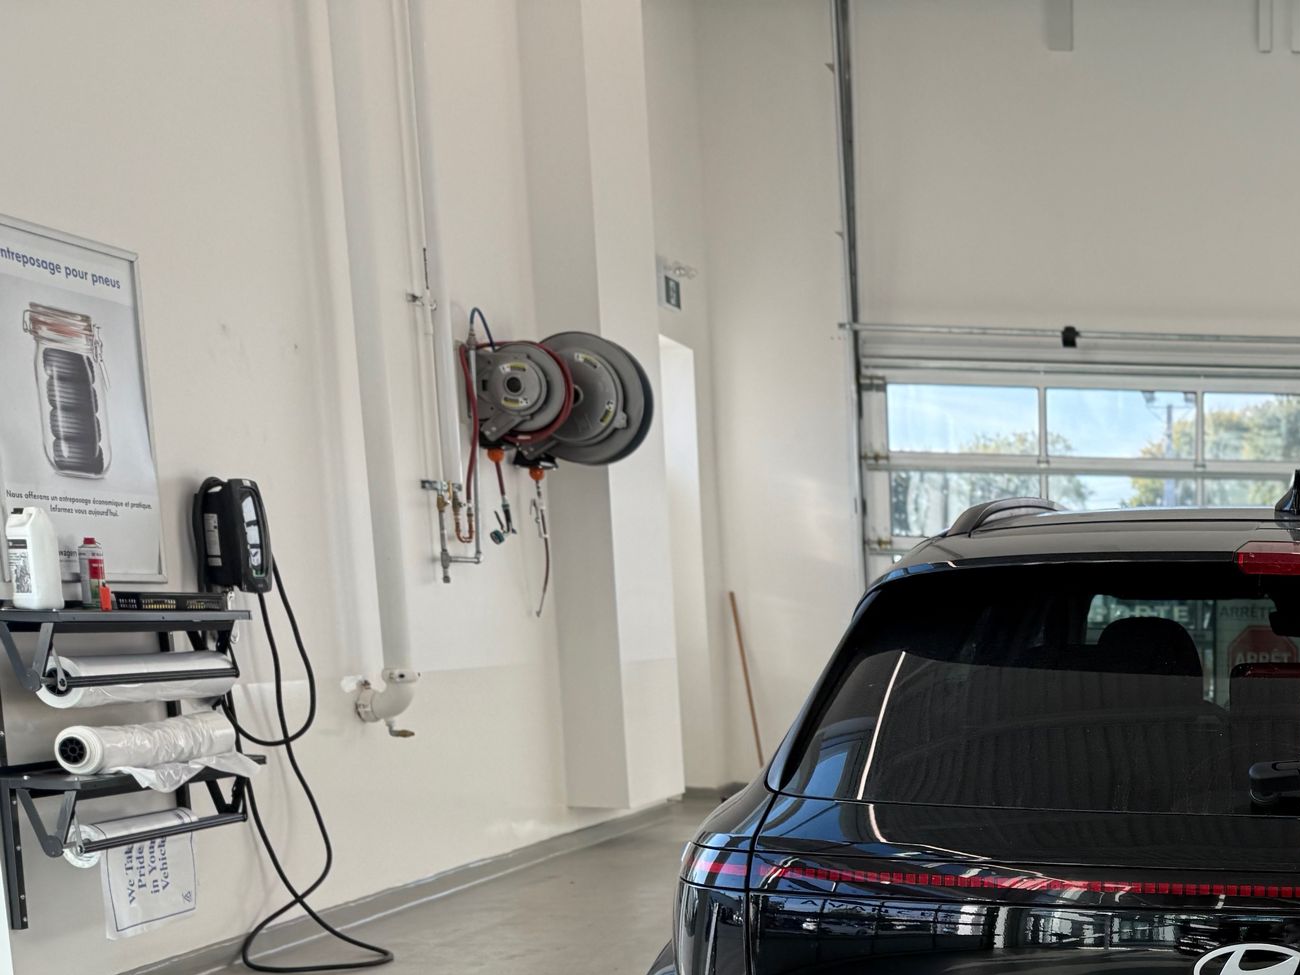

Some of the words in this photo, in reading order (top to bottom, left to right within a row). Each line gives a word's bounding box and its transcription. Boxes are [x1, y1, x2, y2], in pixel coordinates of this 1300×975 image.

[0, 247, 62, 275] ntreposage
[64, 265, 88, 280] pour
[91, 272, 121, 290] pneus
[6, 489, 23, 499] Nous
[124, 844, 134, 876] Tak
[135, 846, 147, 889] Pride
[126, 879, 136, 905] We
[150, 879, 161, 894] in
